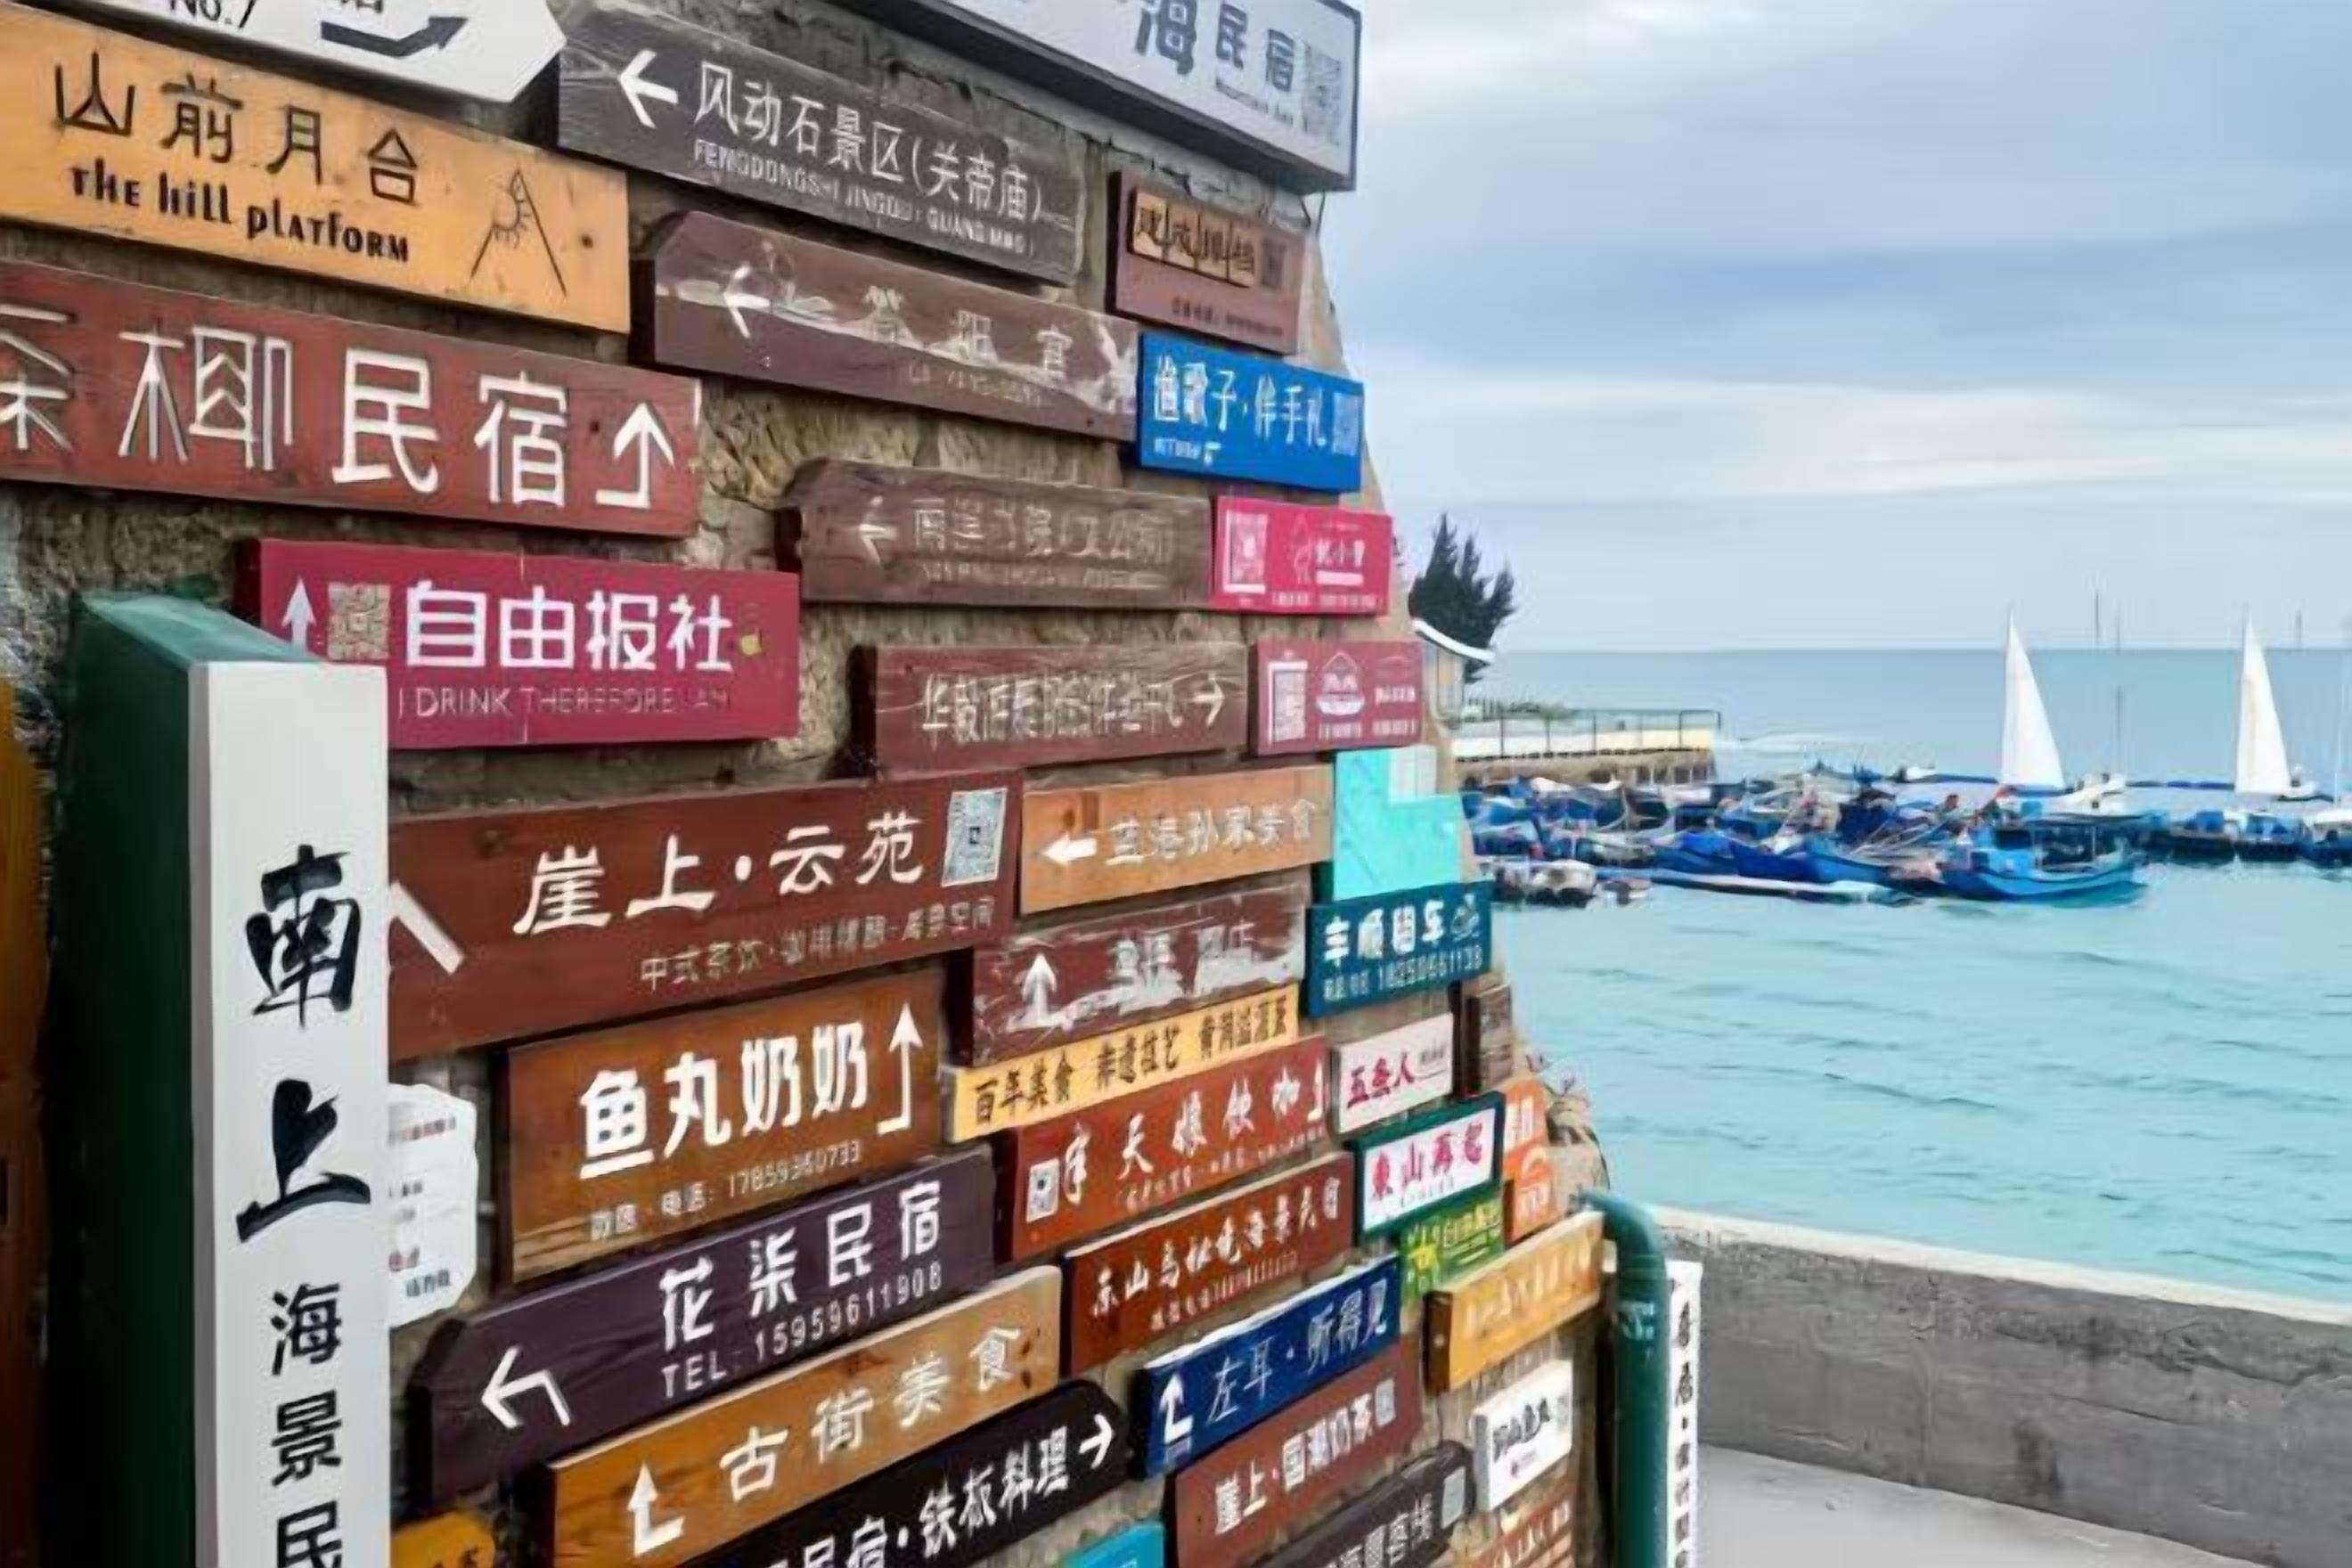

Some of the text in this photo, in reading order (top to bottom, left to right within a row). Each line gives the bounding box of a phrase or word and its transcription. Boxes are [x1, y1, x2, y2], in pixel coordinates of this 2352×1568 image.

[53, 50, 419, 206] 山前月台
[157, 170, 233, 225] hill
[695, 60, 1041, 222] 风动石景区(关帝庙)
[406, 580, 733, 673] 自由报社
[415, 687, 513, 717] DRINK
[579, 1021, 868, 1180] 鱼丸奶奶
[660, 1180, 943, 1353] 花柒民宿
[719, 1326, 1020, 1504] 古街美食
